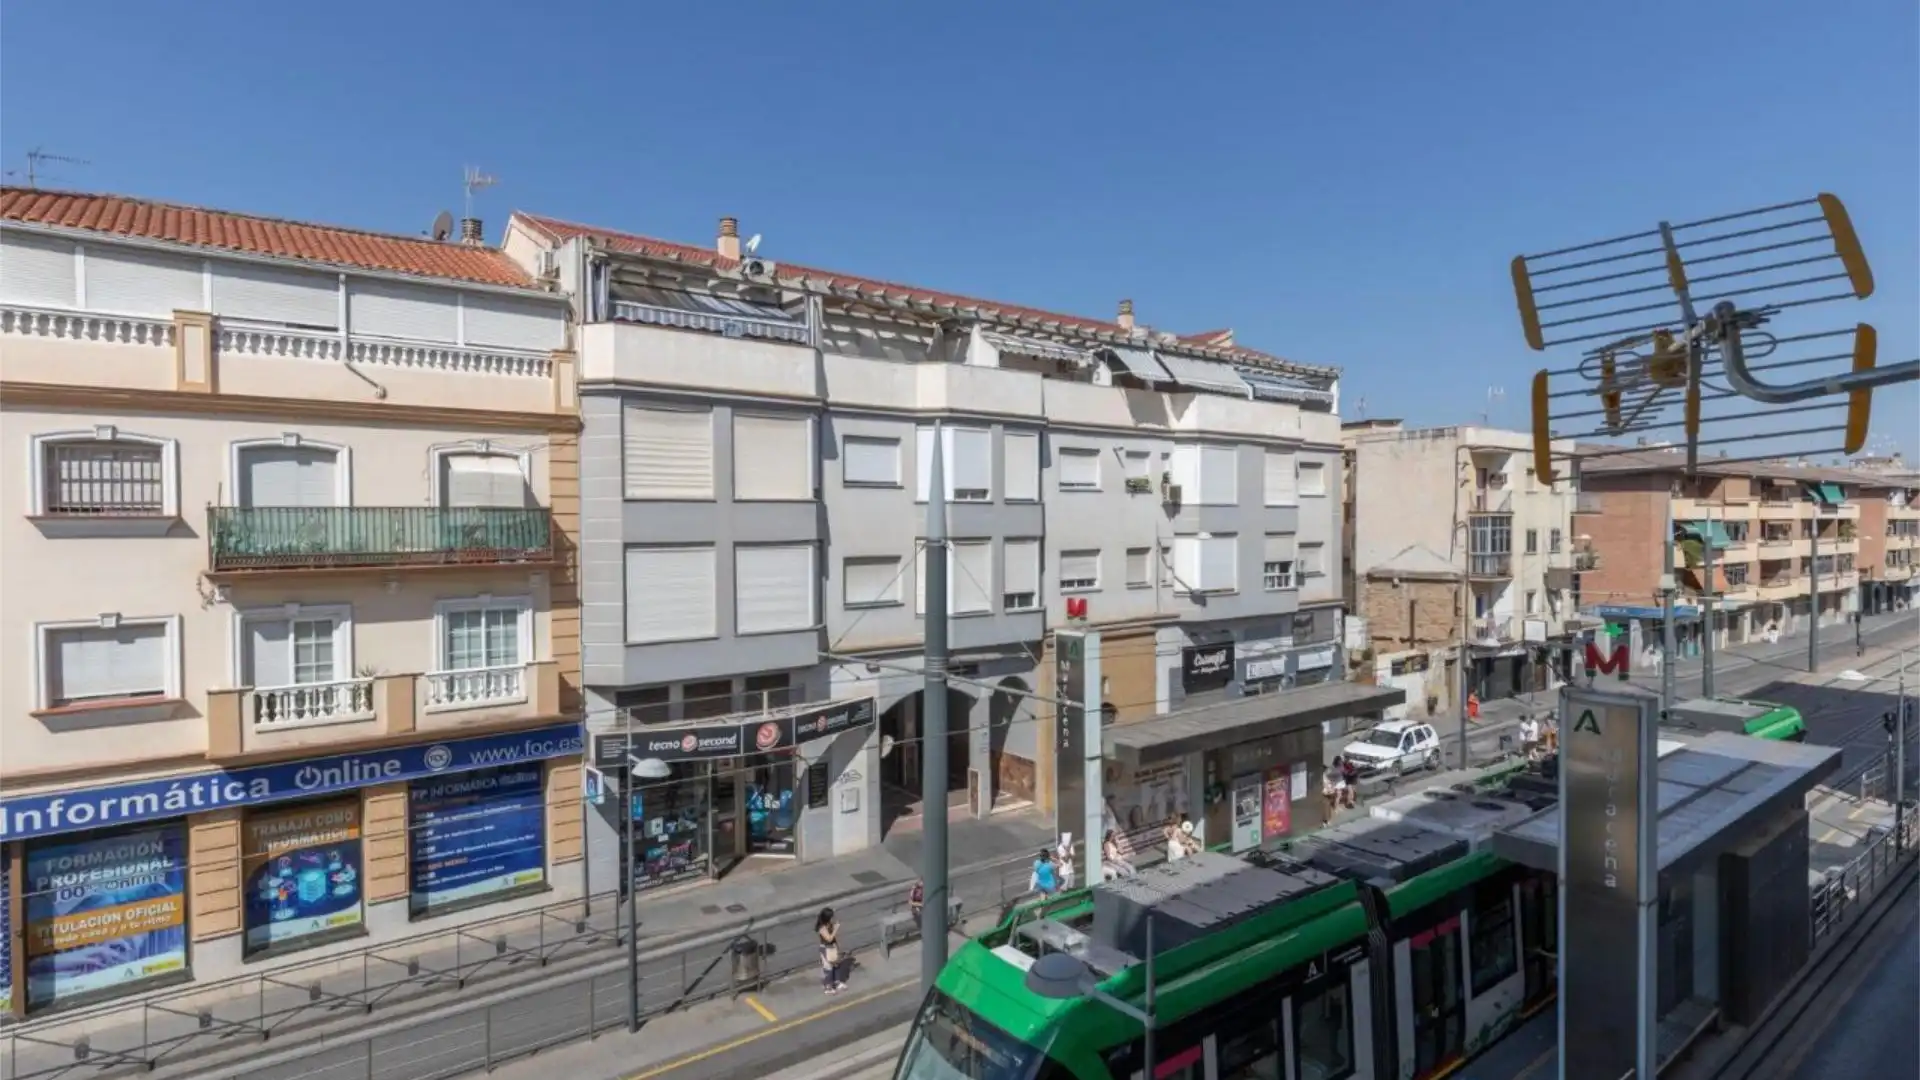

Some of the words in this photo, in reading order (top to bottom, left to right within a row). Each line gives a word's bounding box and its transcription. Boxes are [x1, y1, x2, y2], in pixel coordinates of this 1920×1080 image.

[1584, 642, 1629, 680] M
[468, 738, 582, 764] www.foc.es
[0, 778, 270, 835] Informática
[253, 815, 313, 838] TRABAJA
[315, 810, 354, 827] COMO
[125, 901, 177, 920] OFICIAL
